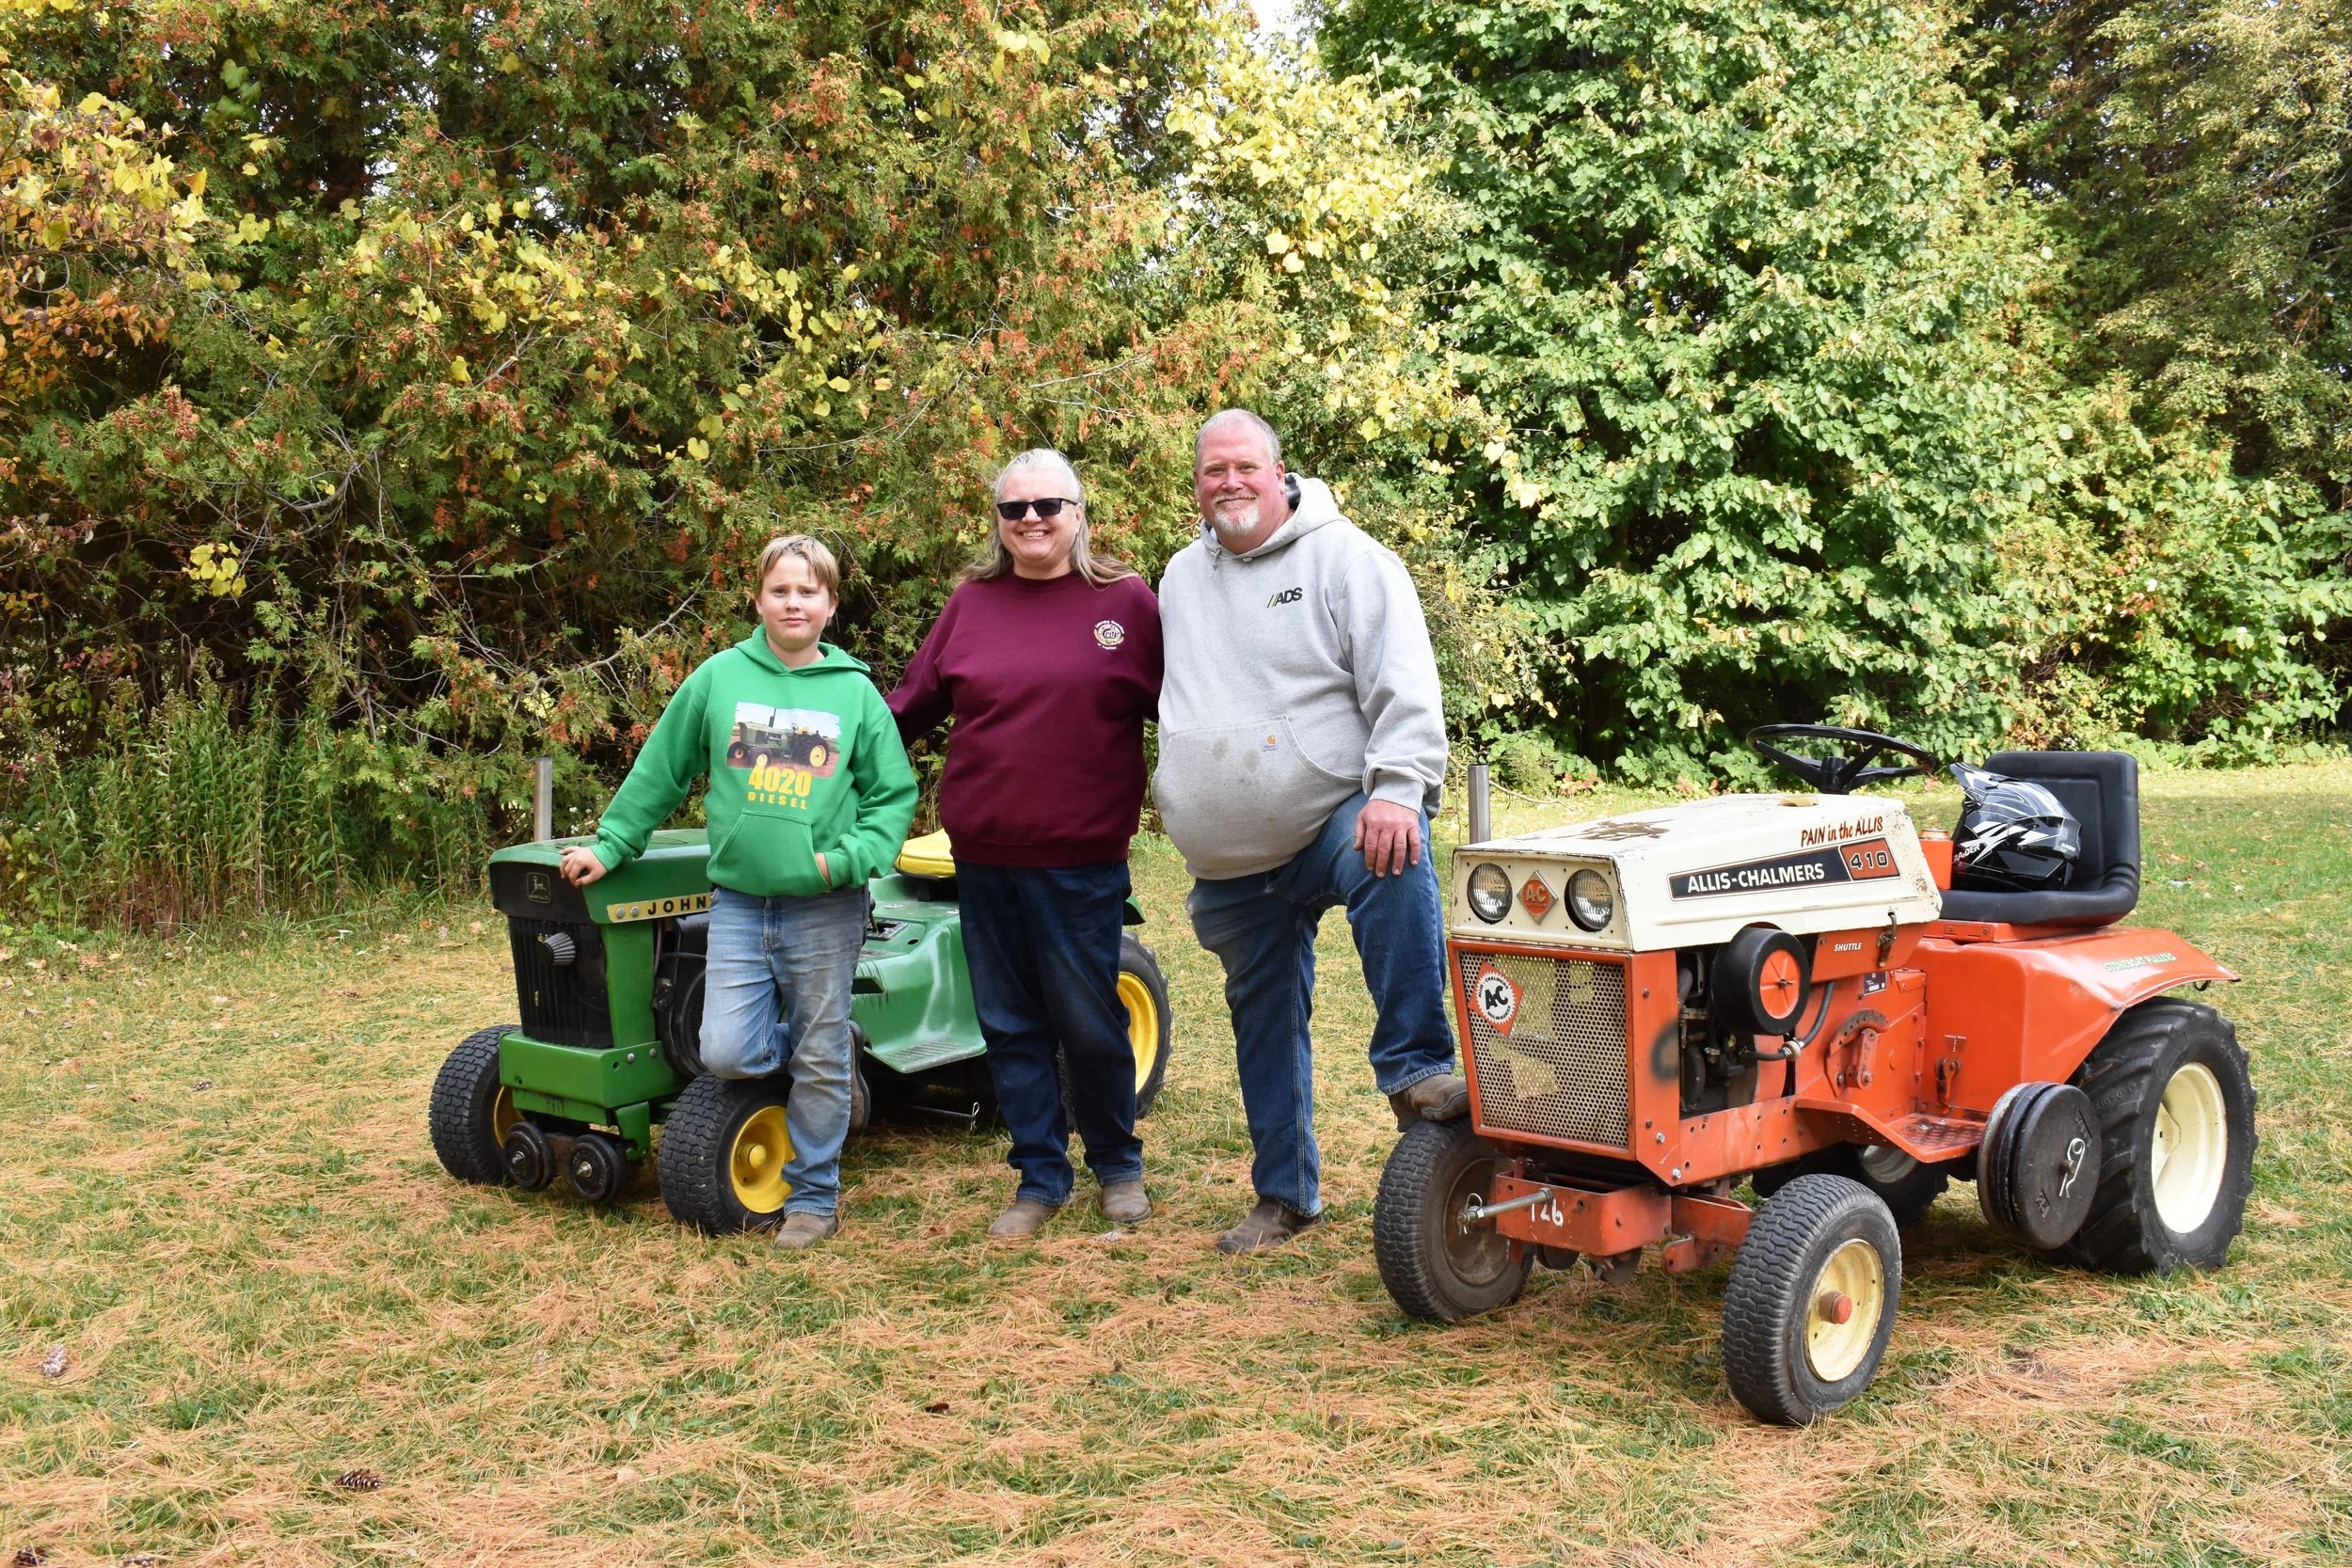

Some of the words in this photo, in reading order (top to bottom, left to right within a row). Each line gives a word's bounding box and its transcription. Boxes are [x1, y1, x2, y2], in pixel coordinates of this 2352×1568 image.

[748, 763, 812, 798] 4020
[748, 791, 807, 810] DIESEL
[1801, 826, 1826, 847] PAIN
[1827, 824, 1837, 842] in
[1838, 821, 1853, 839] the
[1854, 816, 1883, 836] ALLIS
[1850, 850, 1888, 870] 410
[1687, 863, 1825, 894] ALLIS-CHALMERS
[647, 895, 707, 915] JOHN
[1834, 942, 1863, 952] SHUTTLE
